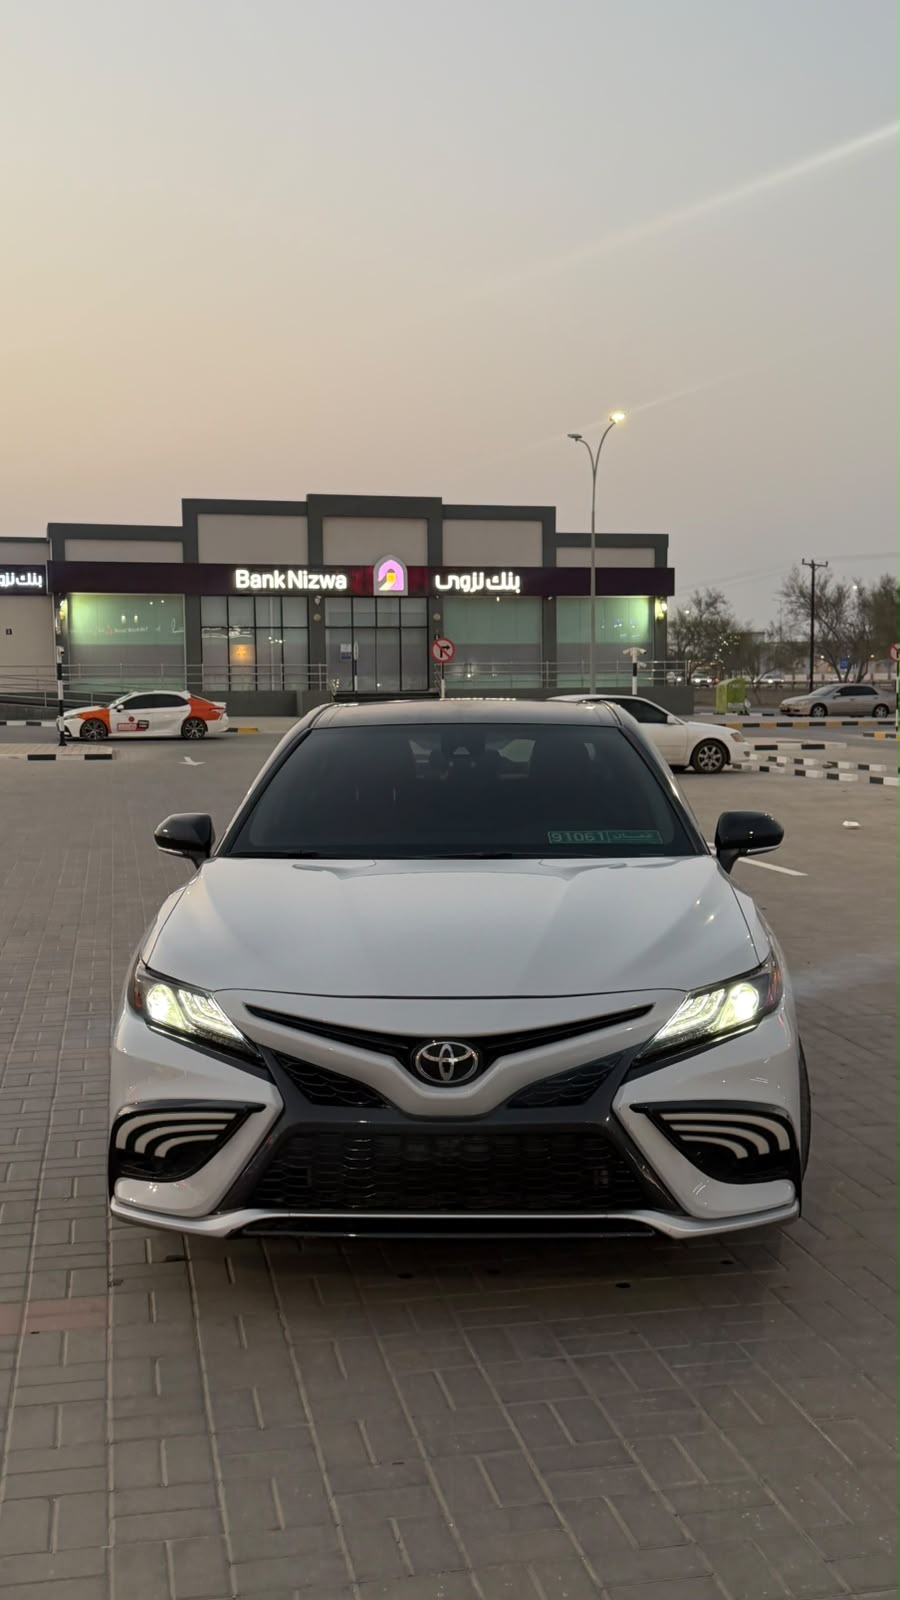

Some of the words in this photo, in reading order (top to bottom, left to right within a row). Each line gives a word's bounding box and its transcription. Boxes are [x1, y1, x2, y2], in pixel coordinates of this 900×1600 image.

[15, 572, 43, 588] بنك
[235, 569, 286, 589] Bank
[287, 569, 347, 590] Nizwa
[435, 571, 485, 593] نزوى
[486, 571, 521, 594] بنك
[550, 831, 605, 842] 91061
